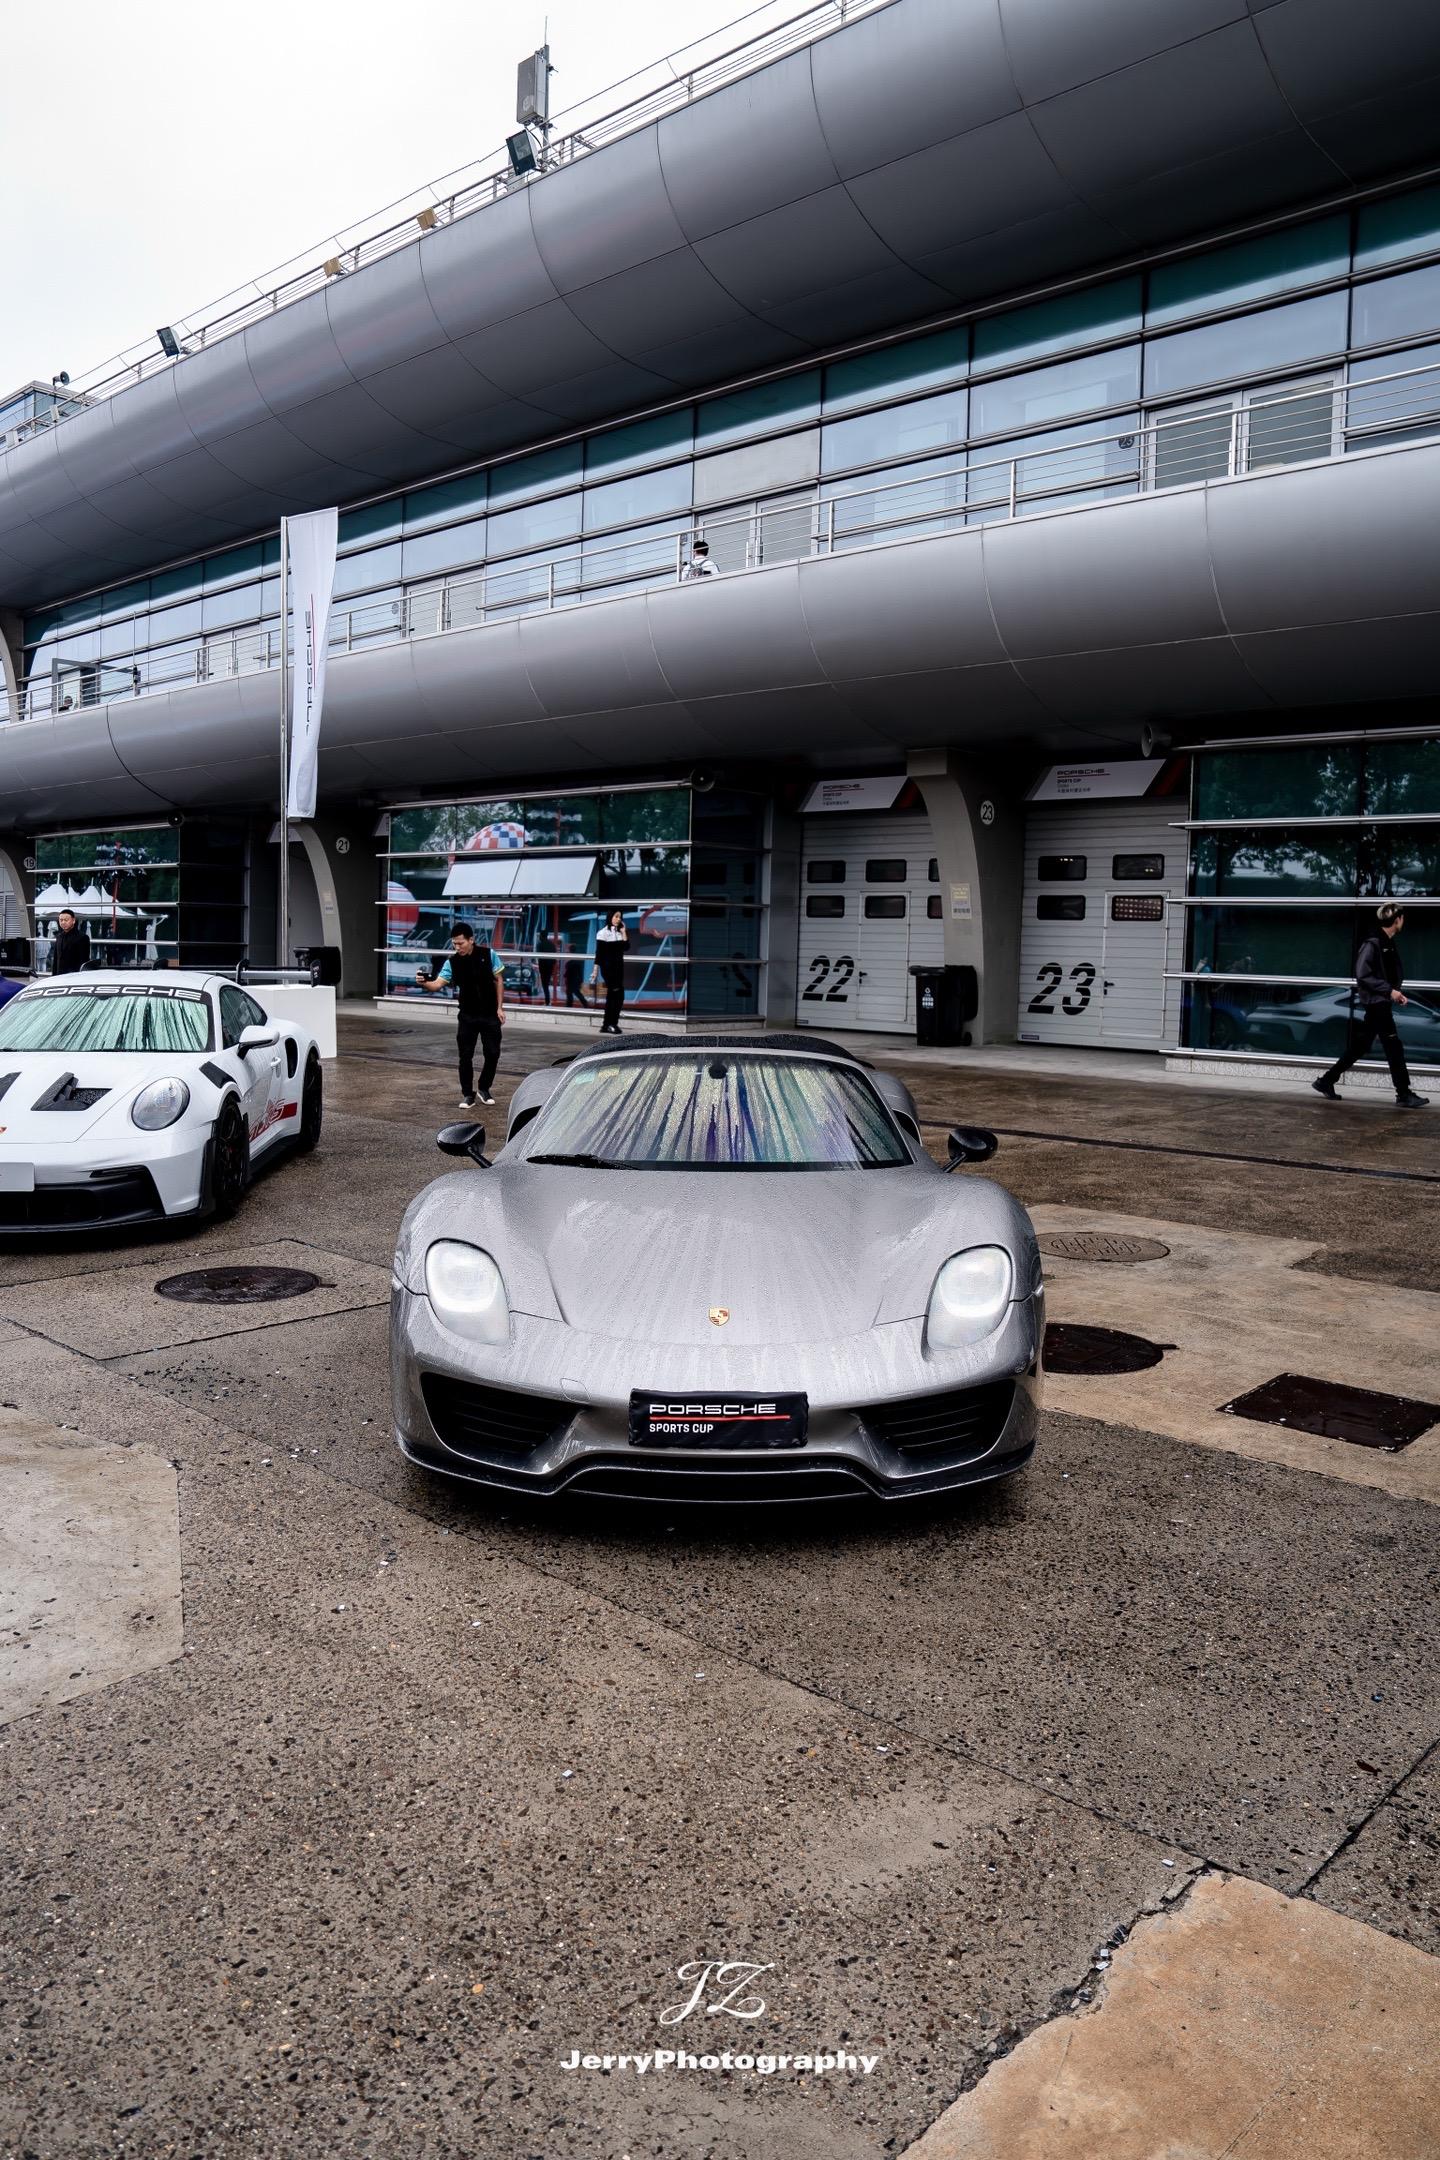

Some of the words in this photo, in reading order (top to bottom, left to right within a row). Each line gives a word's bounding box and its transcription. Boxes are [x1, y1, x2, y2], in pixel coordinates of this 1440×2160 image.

[983, 804, 993, 821] 23
[338, 839, 349, 851] 21
[25, 858, 35, 867] 19
[802, 955, 855, 1003] 22
[20, 986, 202, 1001] PORSCHE
[1027, 962, 1097, 1015] 23
[649, 1403, 776, 1415] PORSCHE
[649, 1423, 690, 1433] SPORTS
[692, 1423, 714, 1434] CUP
